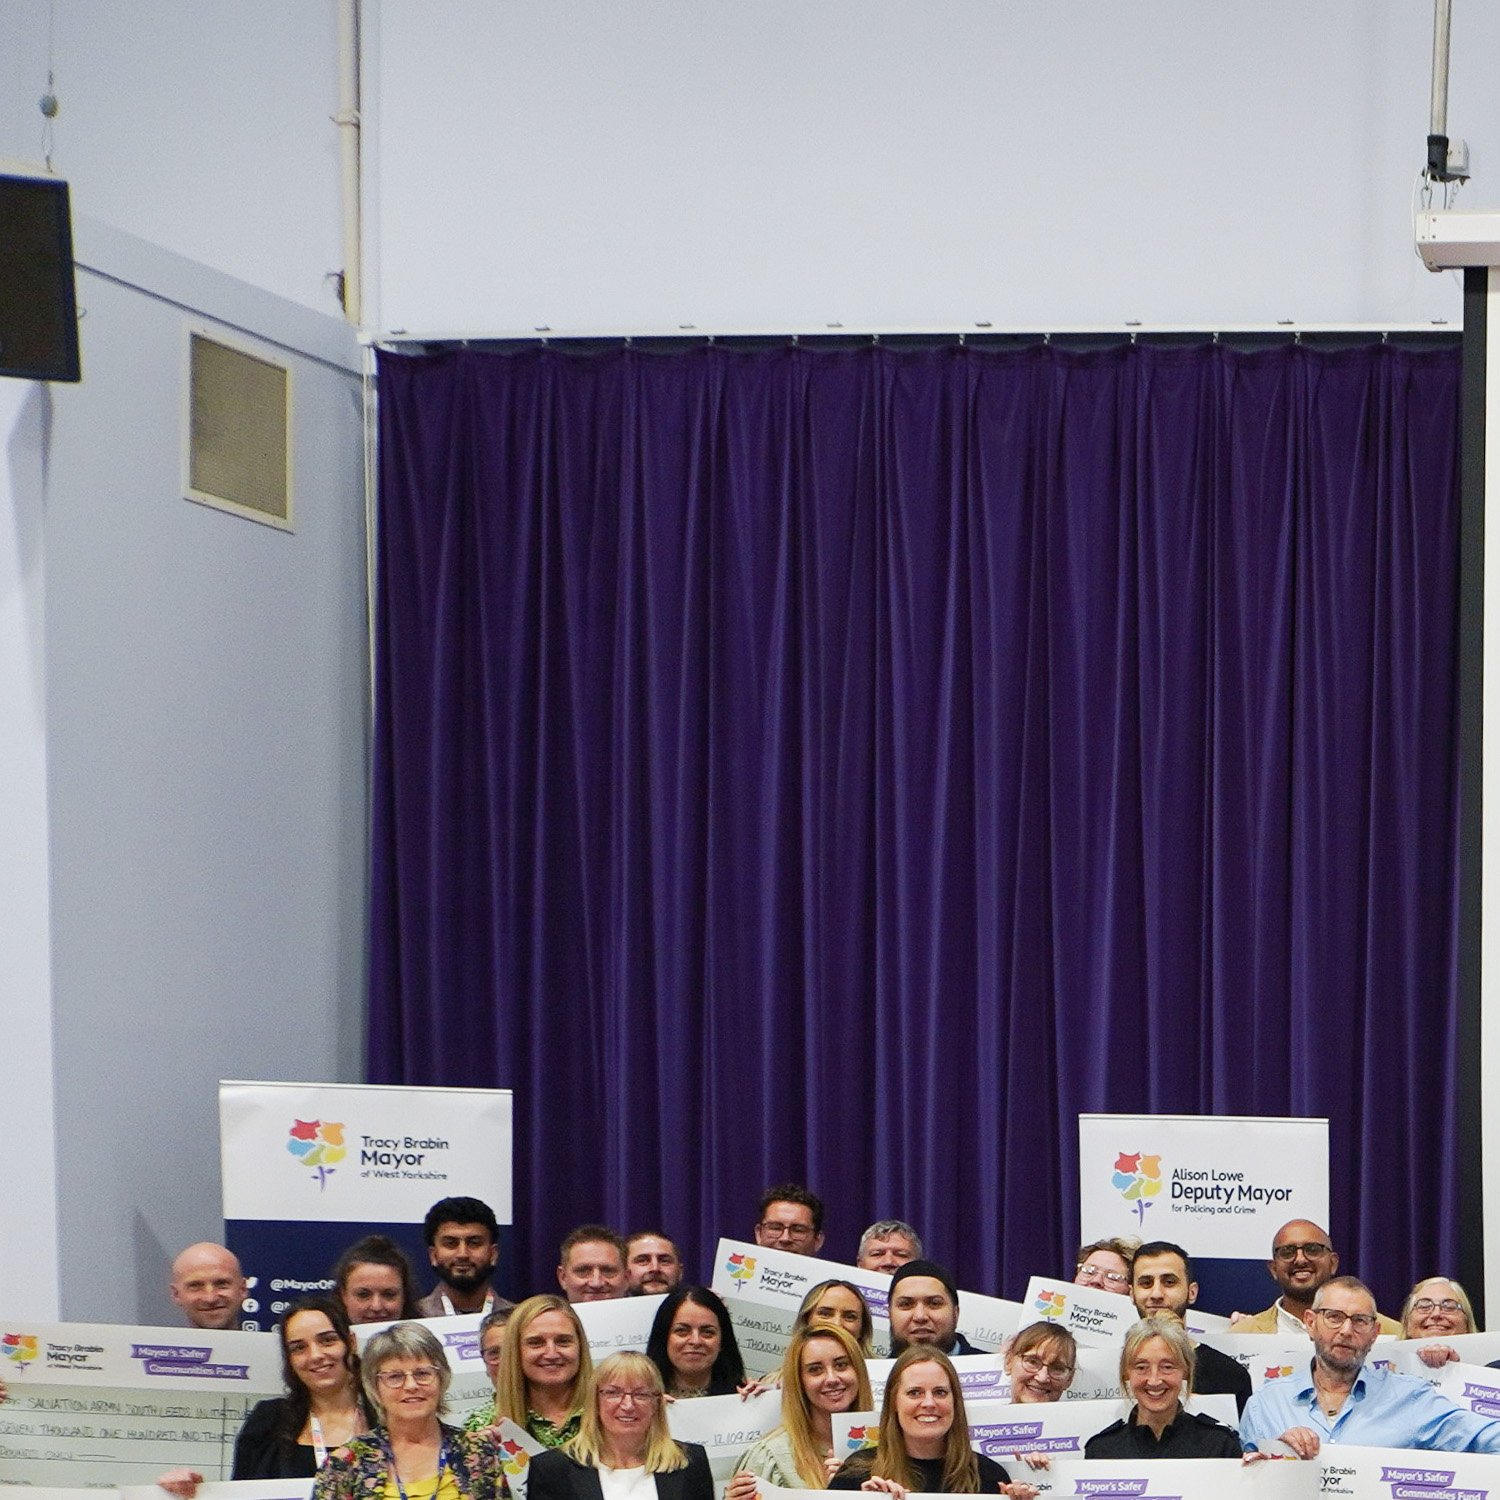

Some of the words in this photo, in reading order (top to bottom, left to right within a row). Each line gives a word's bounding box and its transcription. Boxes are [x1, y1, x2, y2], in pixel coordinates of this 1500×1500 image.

[361, 1135, 400, 1150] Tracy
[404, 1136, 449, 1150] Brabin
[361, 1150, 425, 1169] Mayor
[372, 1169, 400, 1179] West
[401, 1170, 447, 1181] Yorkshire
[1172, 1168, 1208, 1182] Alison
[1211, 1169, 1244, 1182] Lowe
[1171, 1181, 1235, 1204] Deputy
[1238, 1184, 1292, 1205] Mayor
[1171, 1204, 1182, 1213] for
[1184, 1204, 1215, 1215] Policing
[1217, 1205, 1232, 1214] and
[1234, 1206, 1256, 1214] Crime
[1386, 1470, 1420, 1485] Mayor's
[1422, 1472, 1450, 1484] Safer
[1080, 1482, 1116, 1495] Mayor's
[1117, 1481, 1142, 1492] Safer
